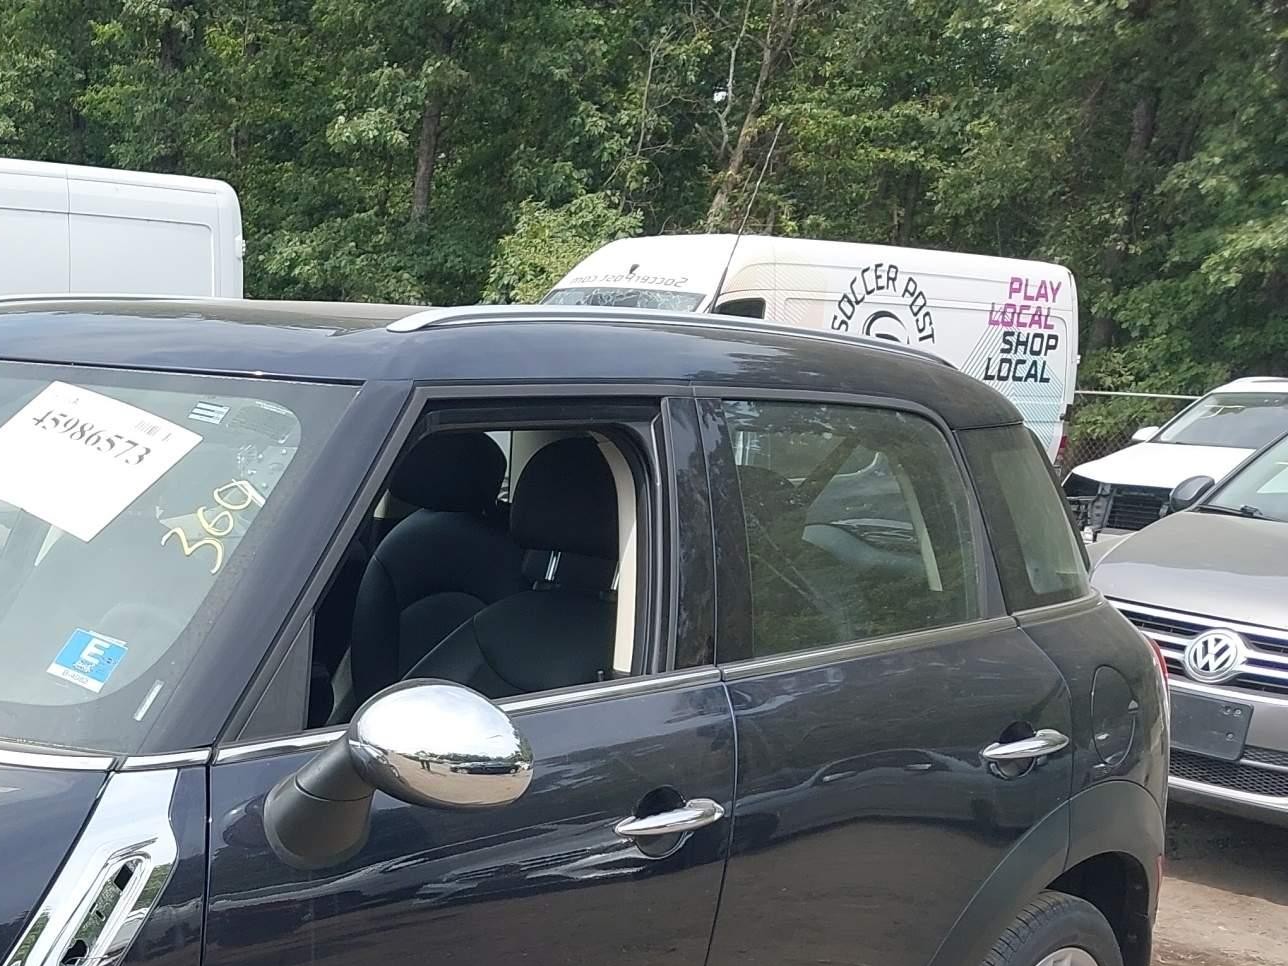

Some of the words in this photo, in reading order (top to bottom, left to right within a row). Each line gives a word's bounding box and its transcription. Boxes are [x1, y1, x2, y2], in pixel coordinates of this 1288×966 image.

[1008, 276, 1062, 303] PLAY
[831, 263, 897, 333] SOCCER
[901, 276, 935, 344] POST
[988, 302, 1055, 330] LOCAL
[1000, 331, 1059, 356] SHOP
[983, 357, 1051, 383] LOCAL
[32, 409, 151, 465] 45986573
[161, 478, 266, 575] 369
[80, 638, 111, 665] E
